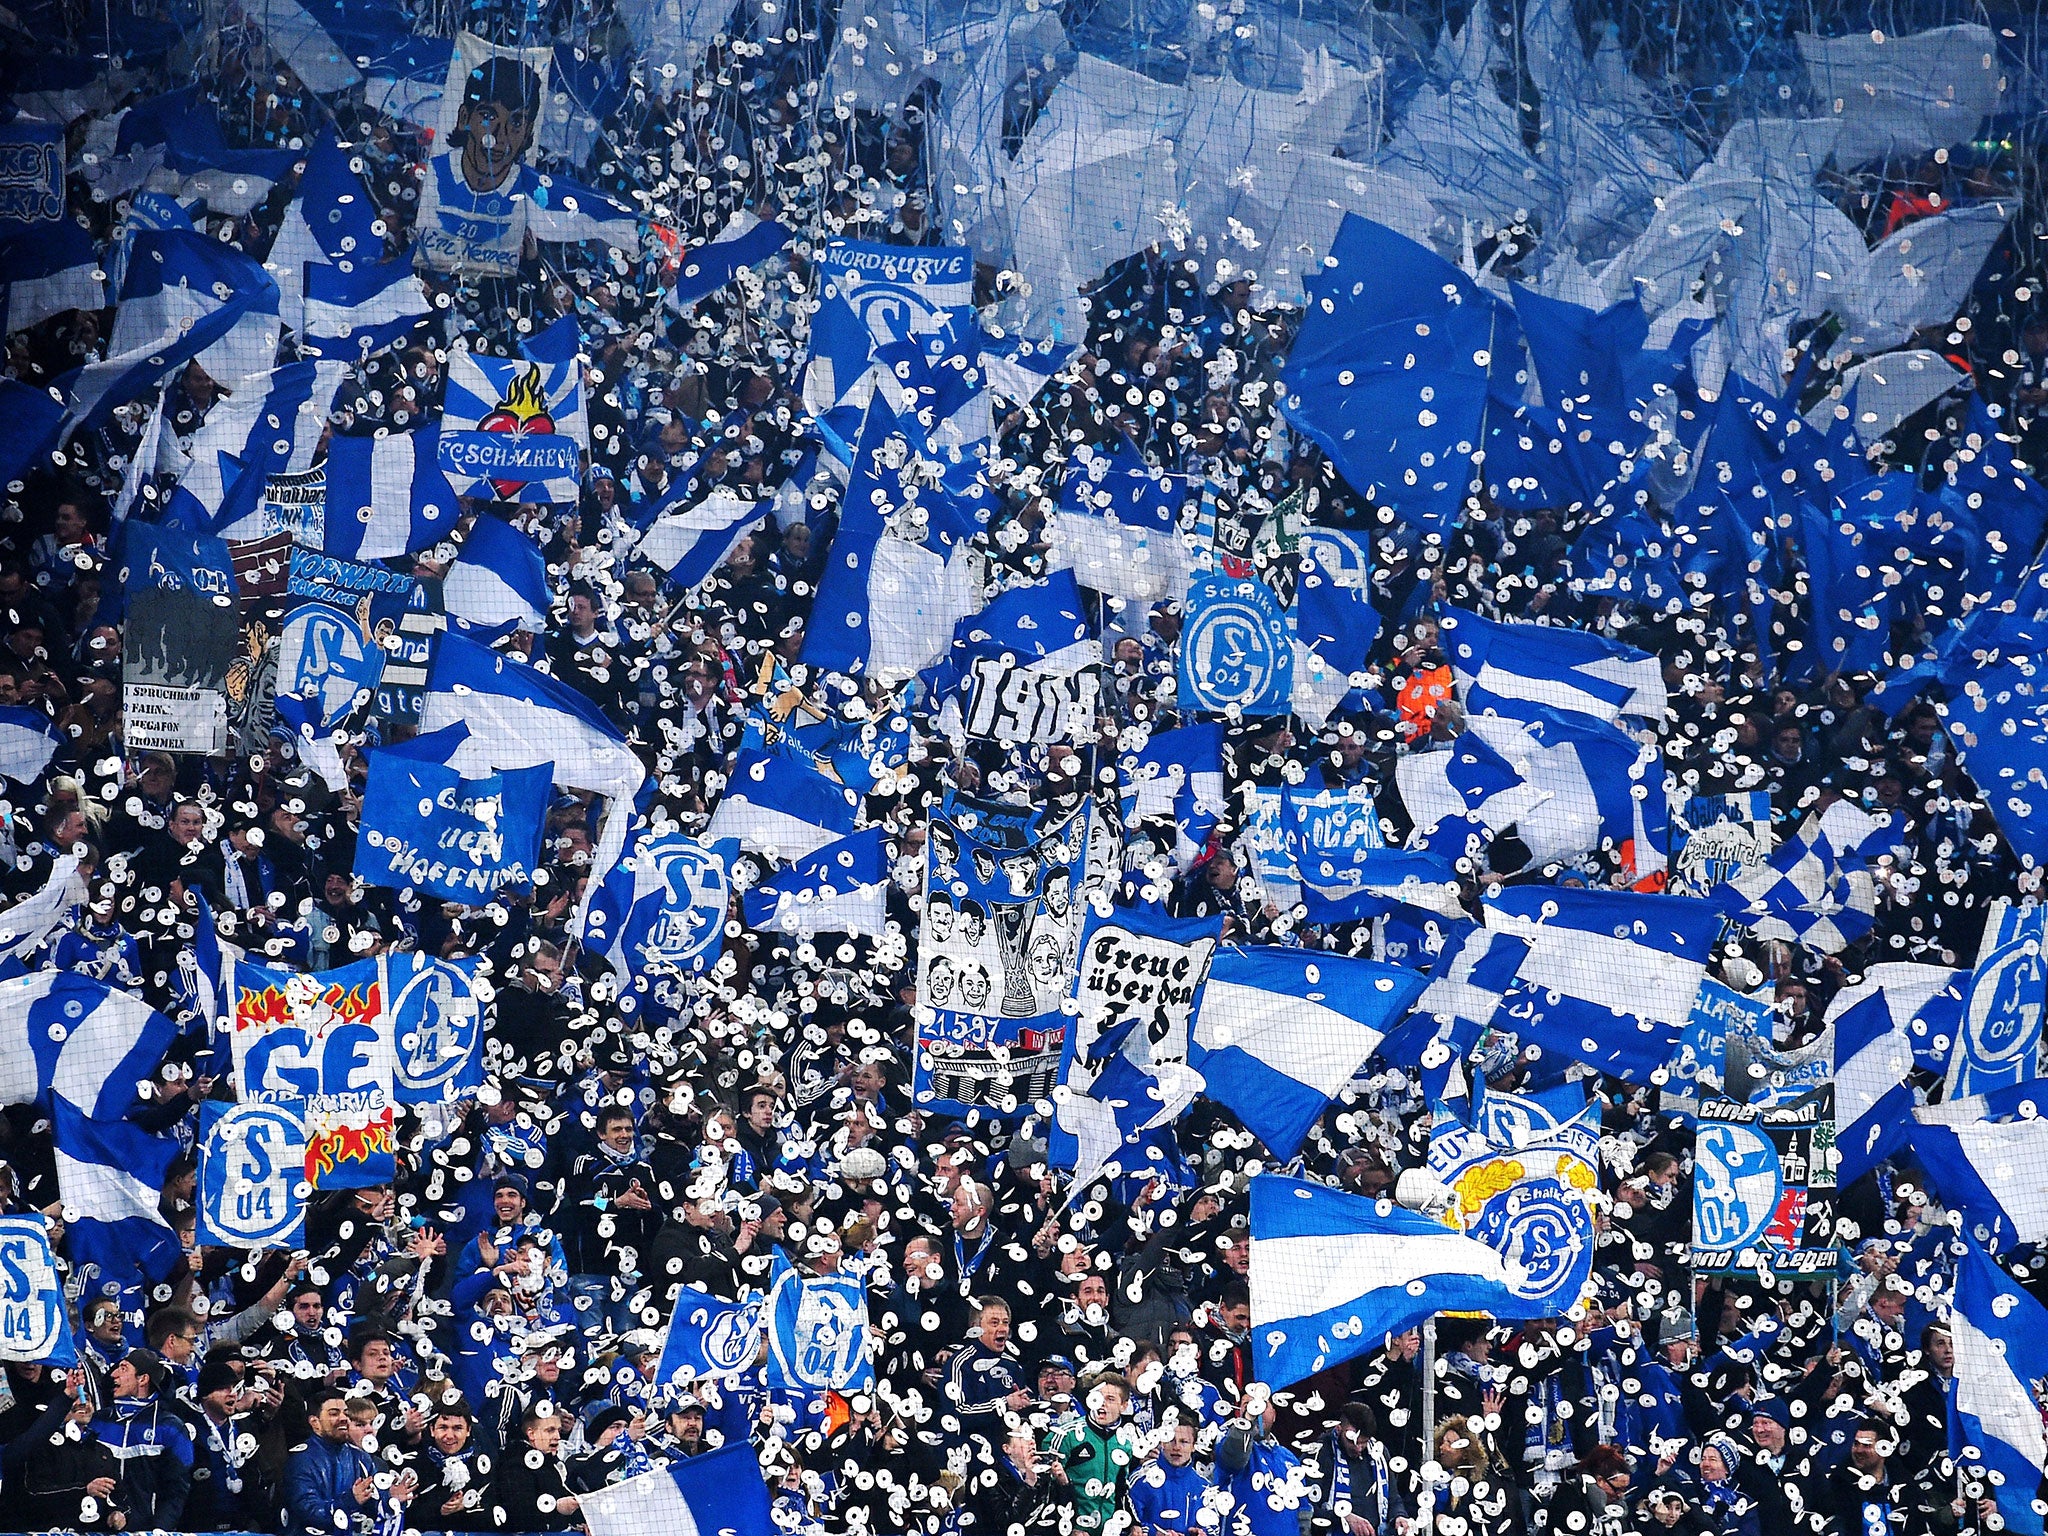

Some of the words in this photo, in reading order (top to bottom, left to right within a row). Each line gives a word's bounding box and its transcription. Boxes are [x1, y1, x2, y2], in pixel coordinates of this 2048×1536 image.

[456, 221, 478, 239] 20
[829, 249, 964, 277] NORDKURVE
[289, 546, 414, 594] VORWÄRTS
[1094, 936, 1190, 982] Treue
[1087, 968, 1154, 1003] über
[1157, 978, 1192, 1006] den
[1097, 1001, 1170, 1045] Td
[1990, 1019, 2016, 1039] 04
[244, 1023, 380, 1094] GE
[248, 1089, 385, 1113] NORKURVE
[3, 1304, 32, 1341] 04
[803, 1344, 836, 1378] 04
